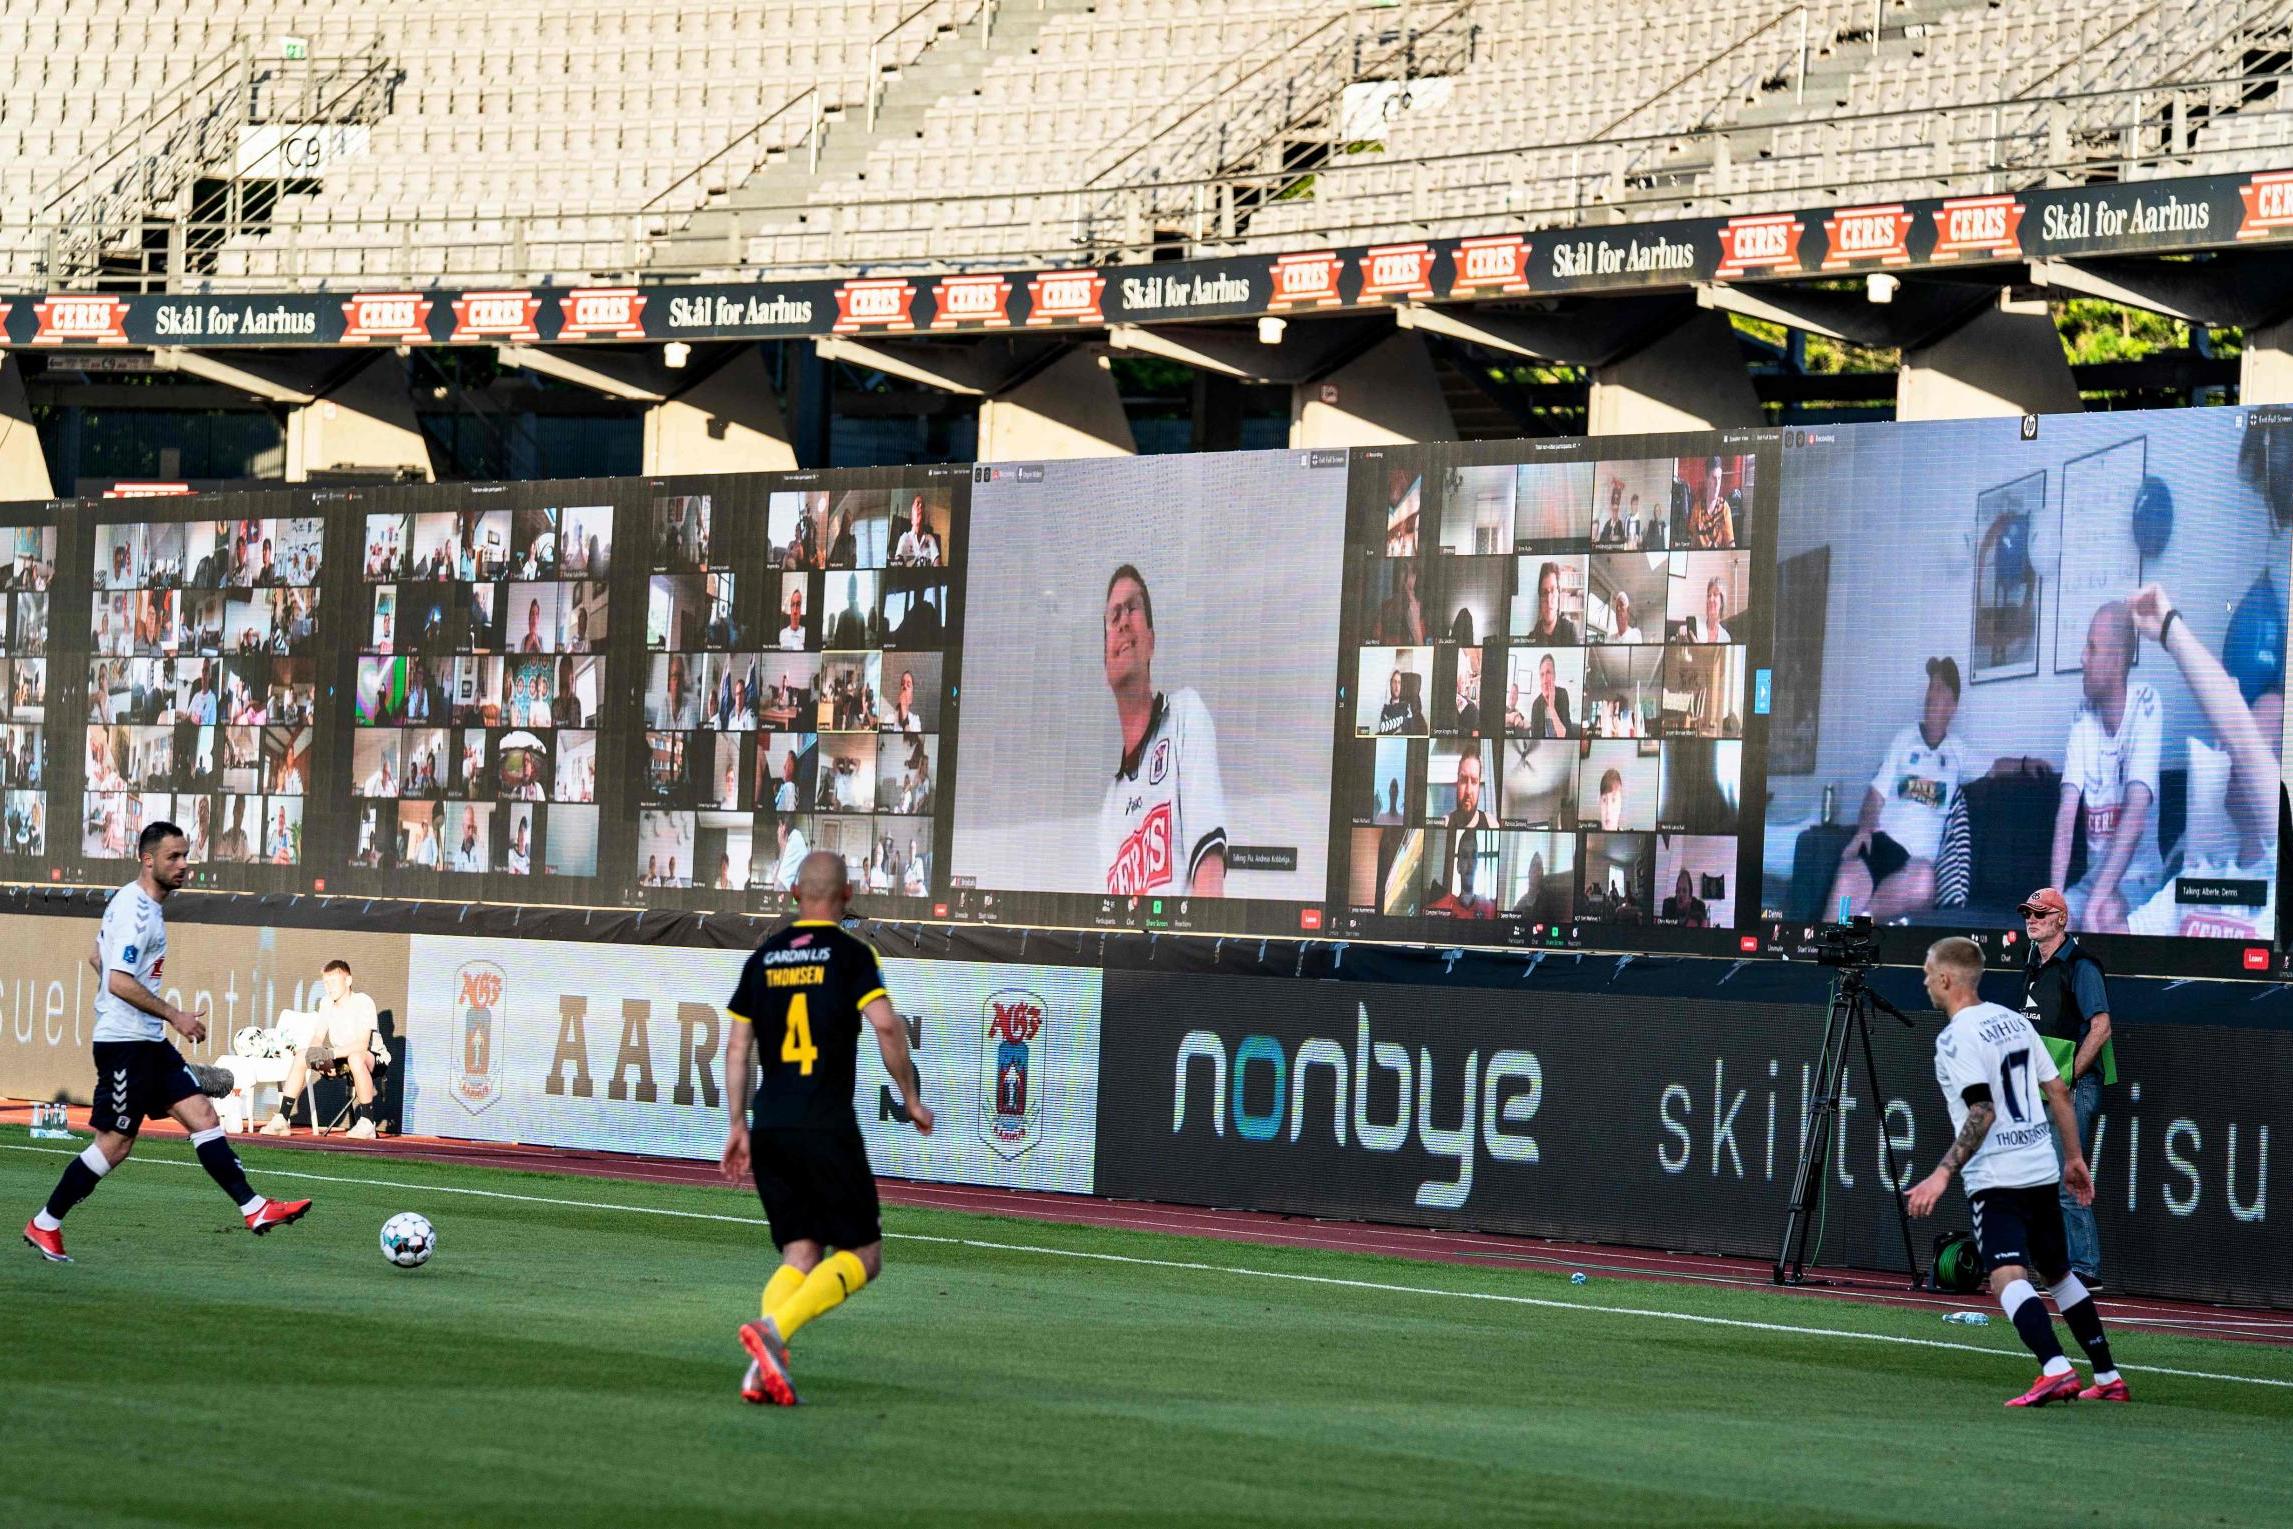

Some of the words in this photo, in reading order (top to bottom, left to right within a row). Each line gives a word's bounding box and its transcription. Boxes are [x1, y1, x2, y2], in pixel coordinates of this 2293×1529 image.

[1840, 215, 1895, 250] CERES
[1950, 206, 2006, 241] CERES
[2042, 201, 2090, 241] Skål
[2095, 200, 2127, 237] for
[2129, 195, 2209, 234] Aarhus
[1553, 241, 1593, 277] Skål
[1596, 240, 1625, 274] for
[1625, 236, 1694, 271] Aarhus
[1734, 224, 1787, 258] CERES
[1283, 262, 1329, 293] CERES
[1373, 253, 1420, 285] CERES
[1466, 246, 1516, 278] CERES
[1122, 275, 1162, 310] Skål
[1165, 275, 1190, 307] for
[1191, 272, 1249, 305] Aarhus
[52, 304, 111, 330] CERES
[156, 305, 203, 335] Skål
[206, 306, 238, 334] for
[240, 305, 316, 334] Aarhus
[669, 296, 711, 327] Skål
[715, 296, 744, 325] for
[744, 294, 812, 325] Aarhus
[766, 966, 825, 987] THOMSEN
[0, 960, 82, 1046] uel
[781, 992, 818, 1076] 4
[2000, 1048, 2031, 1123] 17
[1172, 1001, 1542, 1208] nonbye
